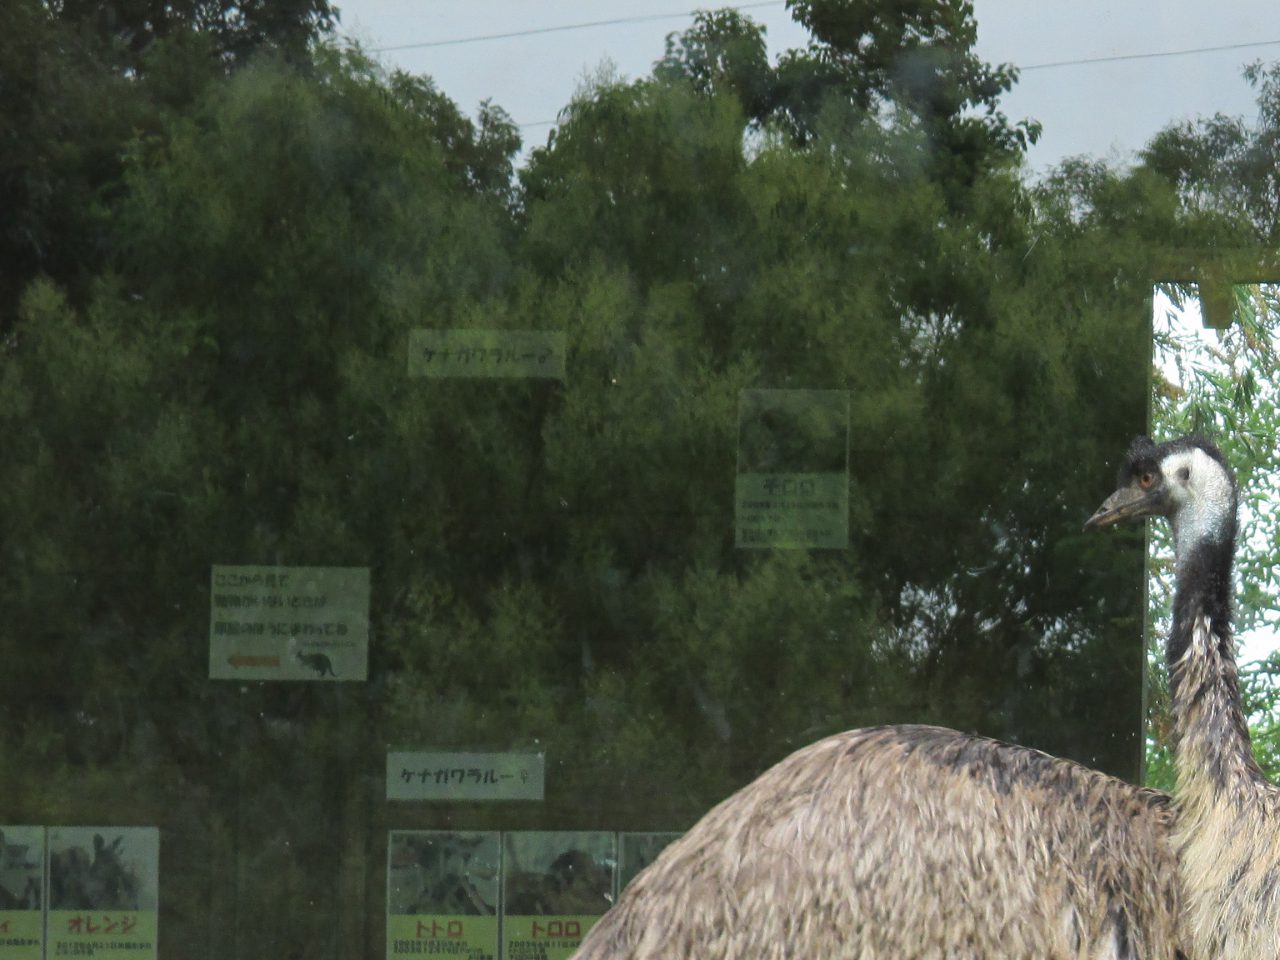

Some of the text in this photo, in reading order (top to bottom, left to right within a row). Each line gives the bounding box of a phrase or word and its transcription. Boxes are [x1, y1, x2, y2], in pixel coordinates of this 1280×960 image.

[401, 767, 514, 784] ケナガワラルー
[67, 915, 137, 934] オレンジ
[416, 919, 465, 938] トトロ
[531, 920, 581, 938] トロロ
